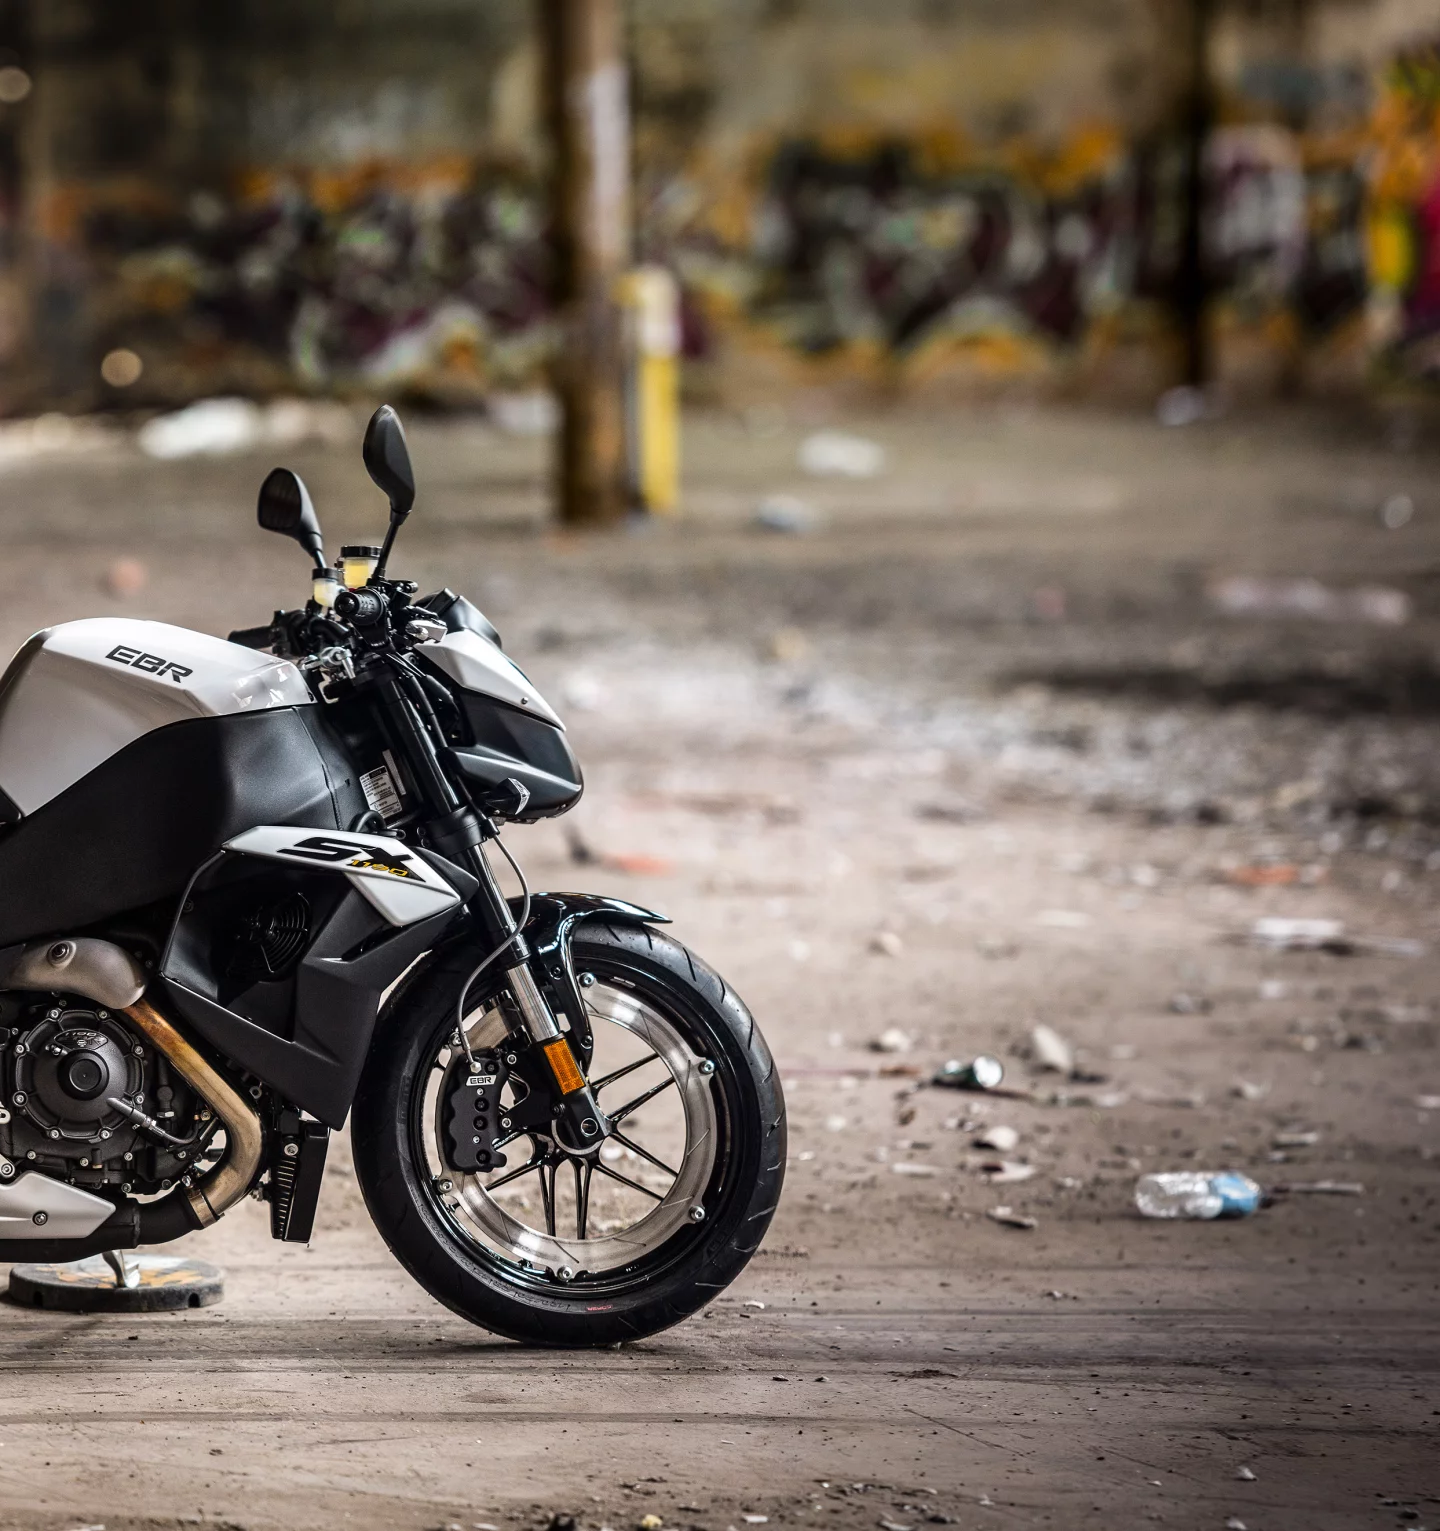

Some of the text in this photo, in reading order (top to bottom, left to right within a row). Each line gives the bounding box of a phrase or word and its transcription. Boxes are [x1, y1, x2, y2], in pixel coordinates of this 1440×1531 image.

[105, 644, 194, 684] EBR
[276, 836, 427, 883] SX
[469, 1076, 492, 1085] EBR
